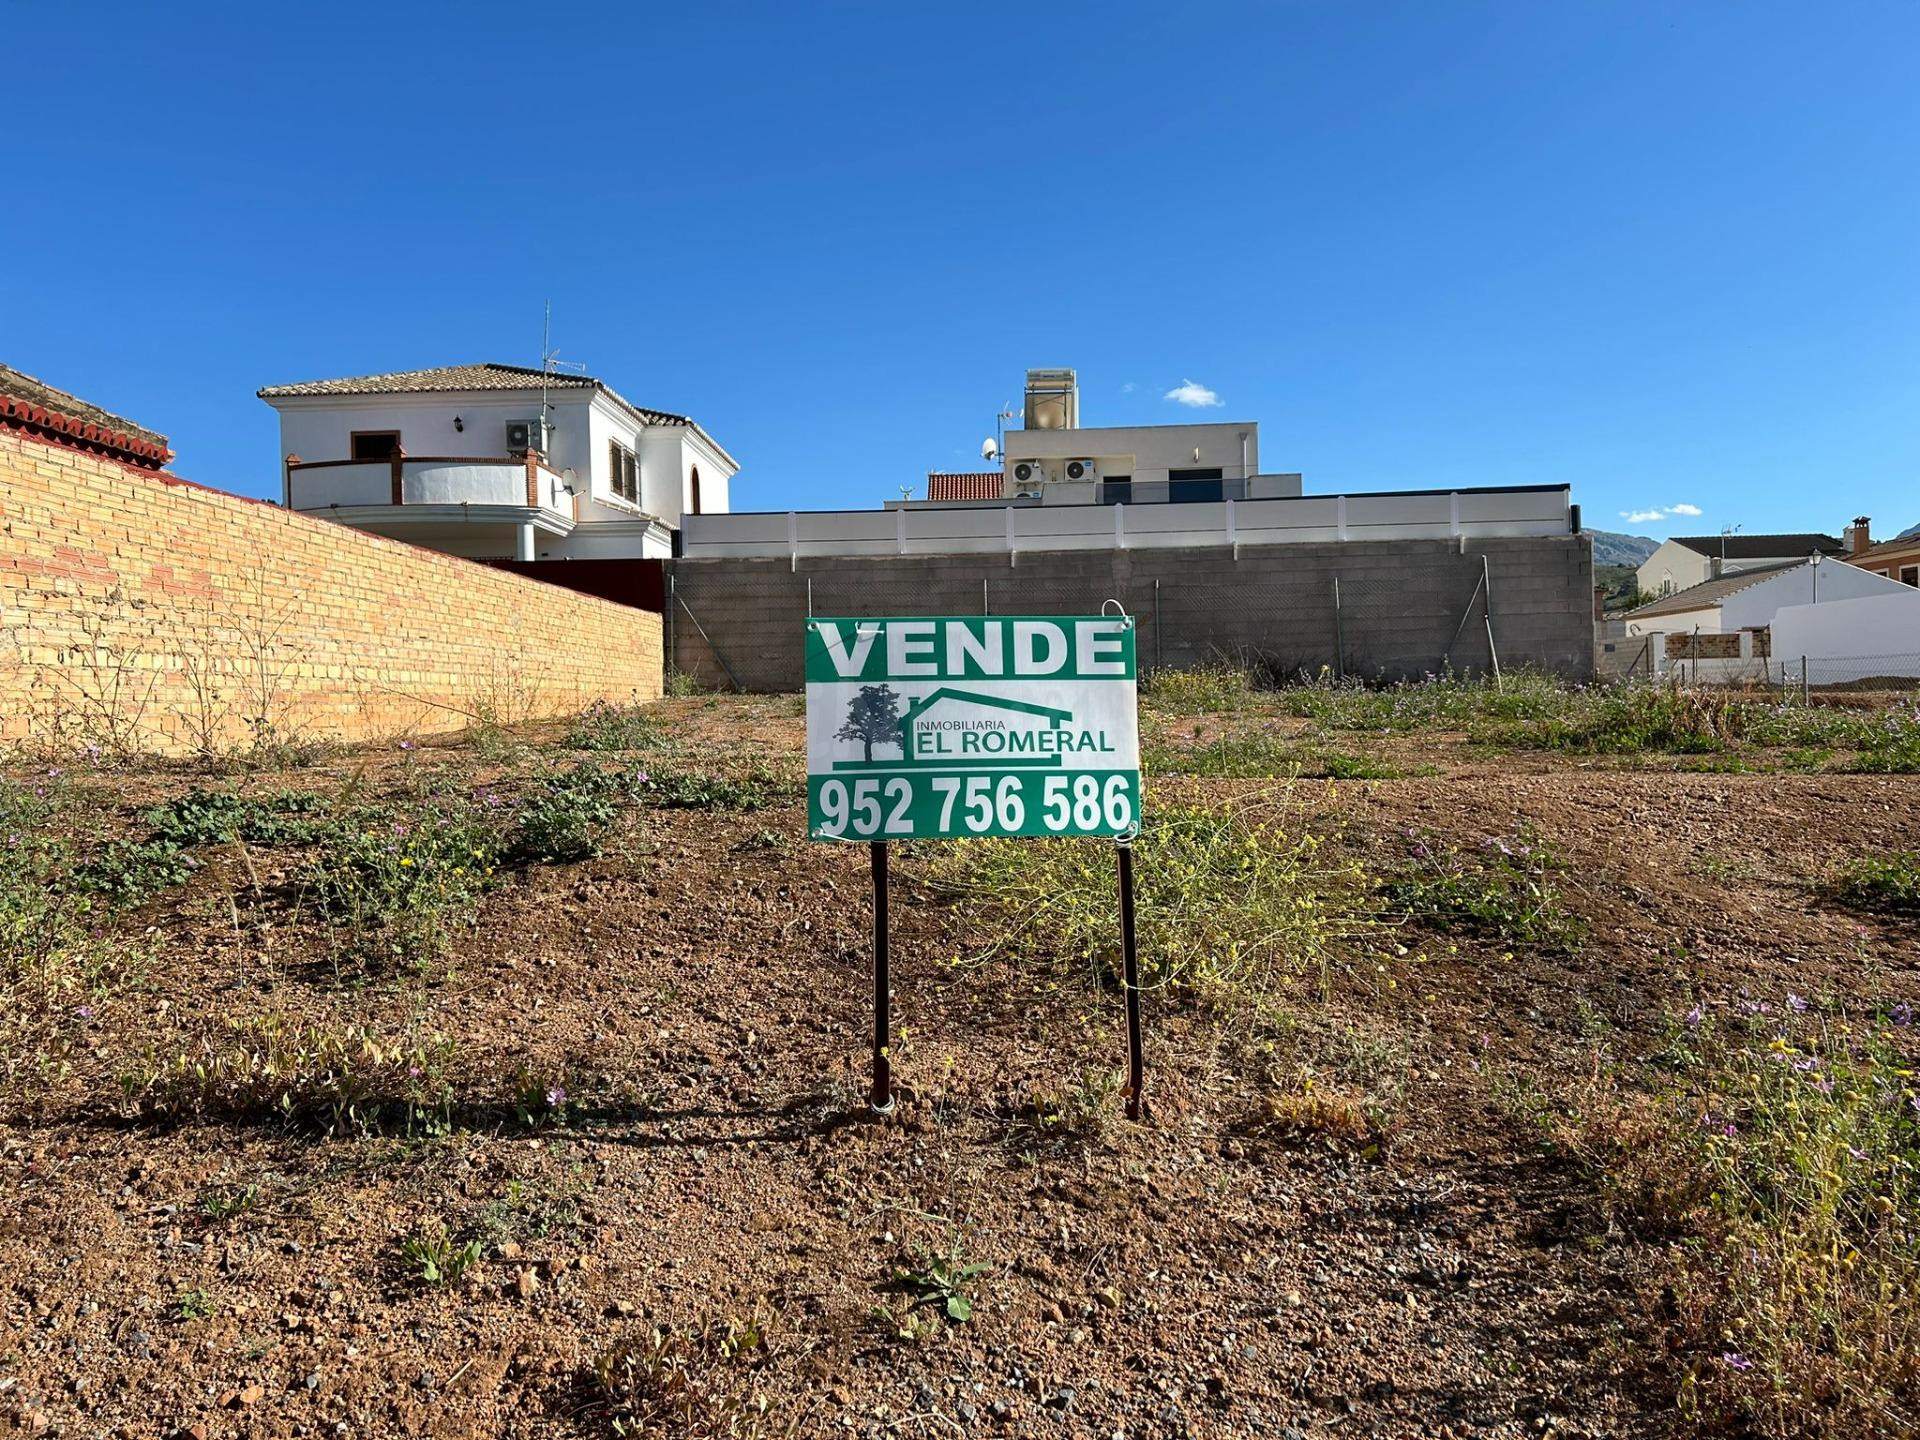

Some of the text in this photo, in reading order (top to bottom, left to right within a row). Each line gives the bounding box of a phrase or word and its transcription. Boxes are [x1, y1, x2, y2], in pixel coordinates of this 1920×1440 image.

[818, 621, 1126, 677] VENDE
[916, 720, 1006, 731] INMOBILIARIA
[917, 730, 1115, 754] EL ROMERAL
[819, 774, 1132, 836] 952 756 586
